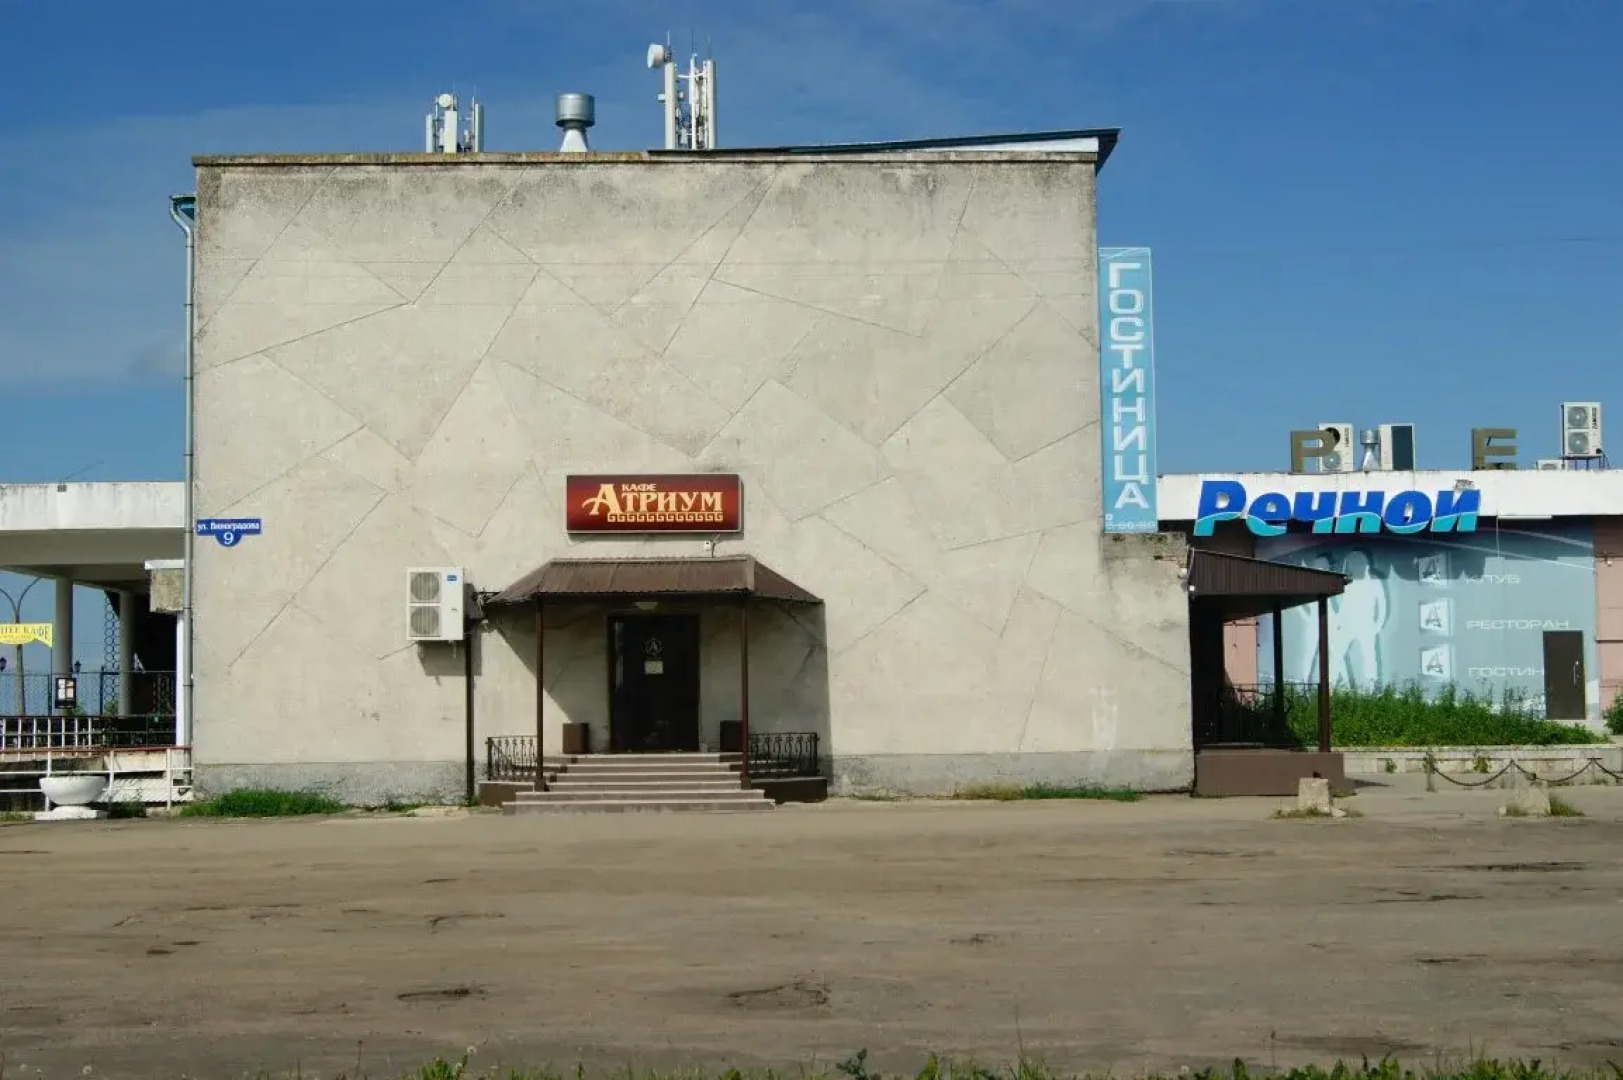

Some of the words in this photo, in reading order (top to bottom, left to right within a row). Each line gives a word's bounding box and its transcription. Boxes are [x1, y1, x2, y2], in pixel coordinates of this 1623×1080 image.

[1108, 262, 1150, 509] ГОСТИНИЦА
[621, 483, 657, 492] КАФЕ
[1193, 480, 1480, 536] Речной
[223, 531, 234, 545] 9
[1466, 619, 1570, 630] РЕСТОРАН
